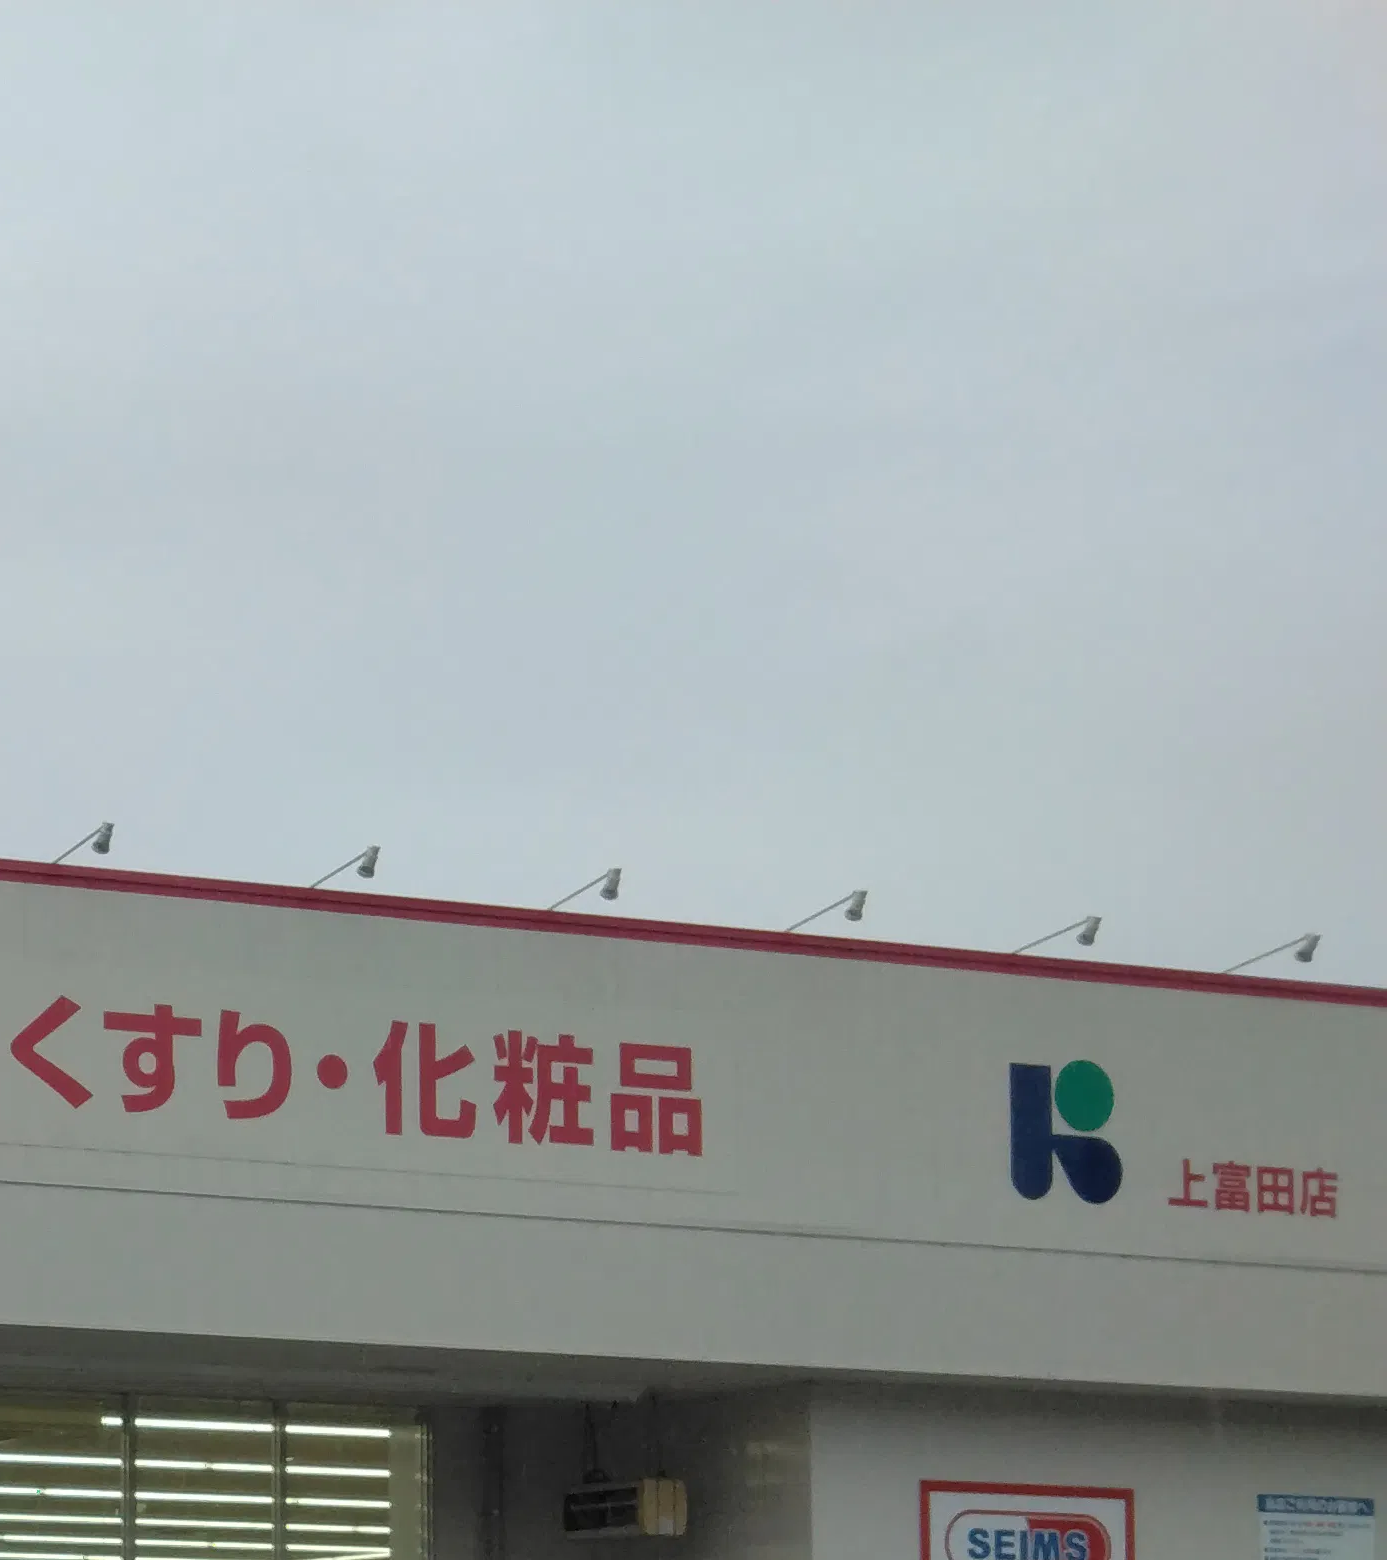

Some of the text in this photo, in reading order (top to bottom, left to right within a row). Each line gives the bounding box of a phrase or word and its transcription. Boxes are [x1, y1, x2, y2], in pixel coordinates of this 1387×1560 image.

[10, 995, 702, 1156] くすり・化粧品
[1168, 1158, 1338, 1218] 上富田店
